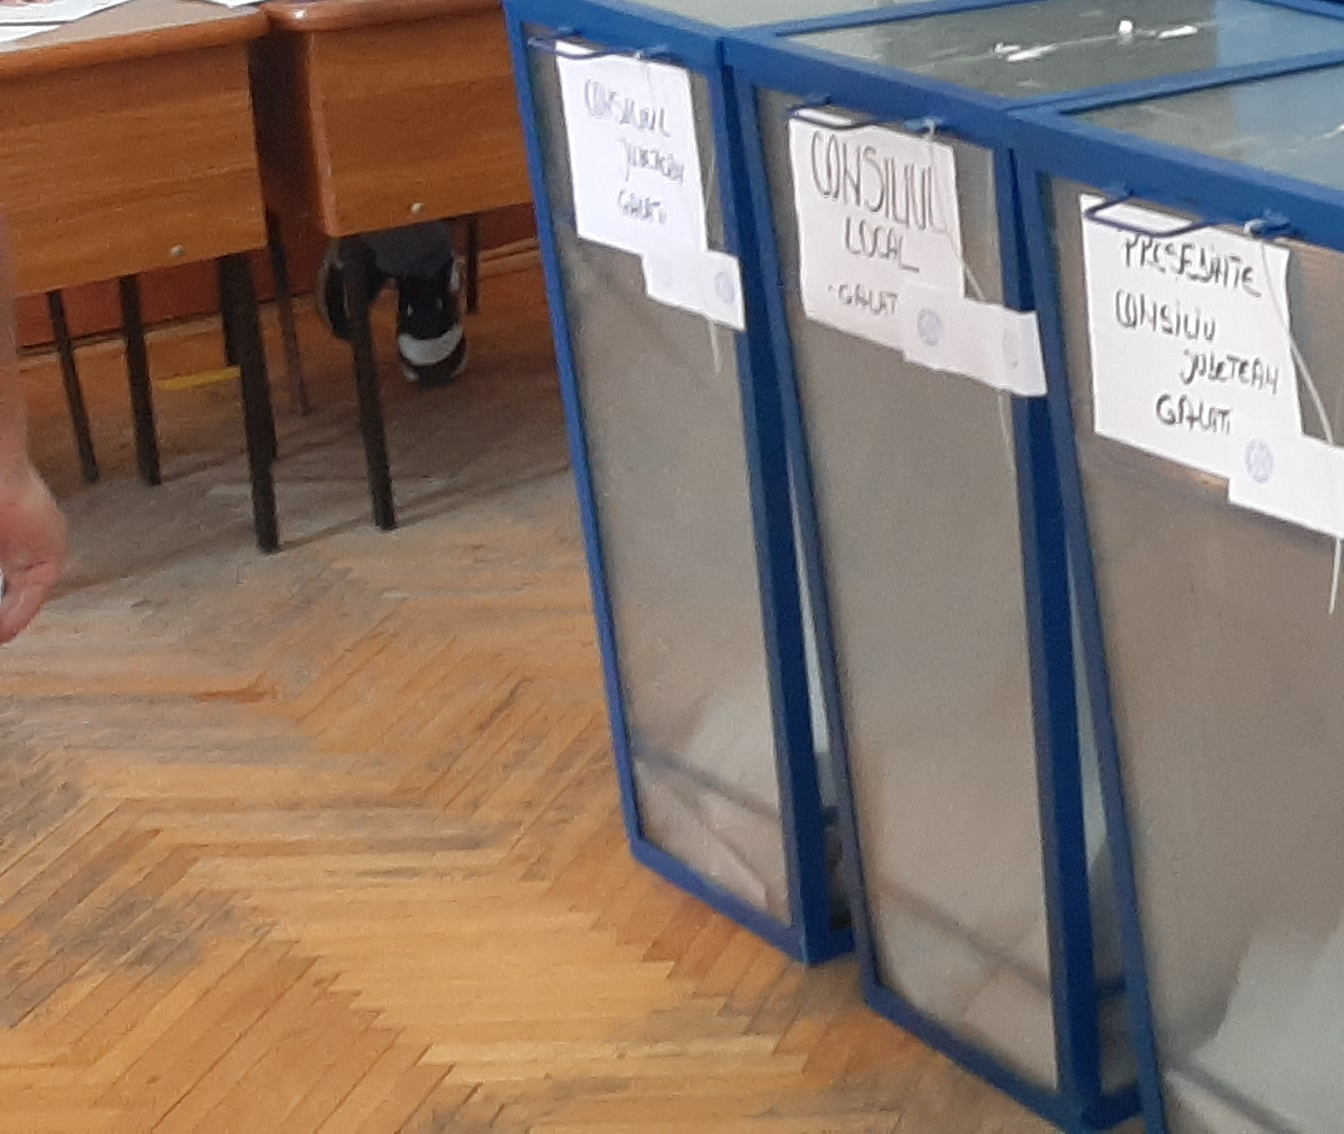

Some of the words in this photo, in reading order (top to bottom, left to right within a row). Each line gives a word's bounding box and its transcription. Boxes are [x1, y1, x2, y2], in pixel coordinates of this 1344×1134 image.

[810, 130, 947, 234] CONSILIUL
[843, 216, 920, 273] LOCAL
[1115, 287, 1216, 342] CONSILIU
